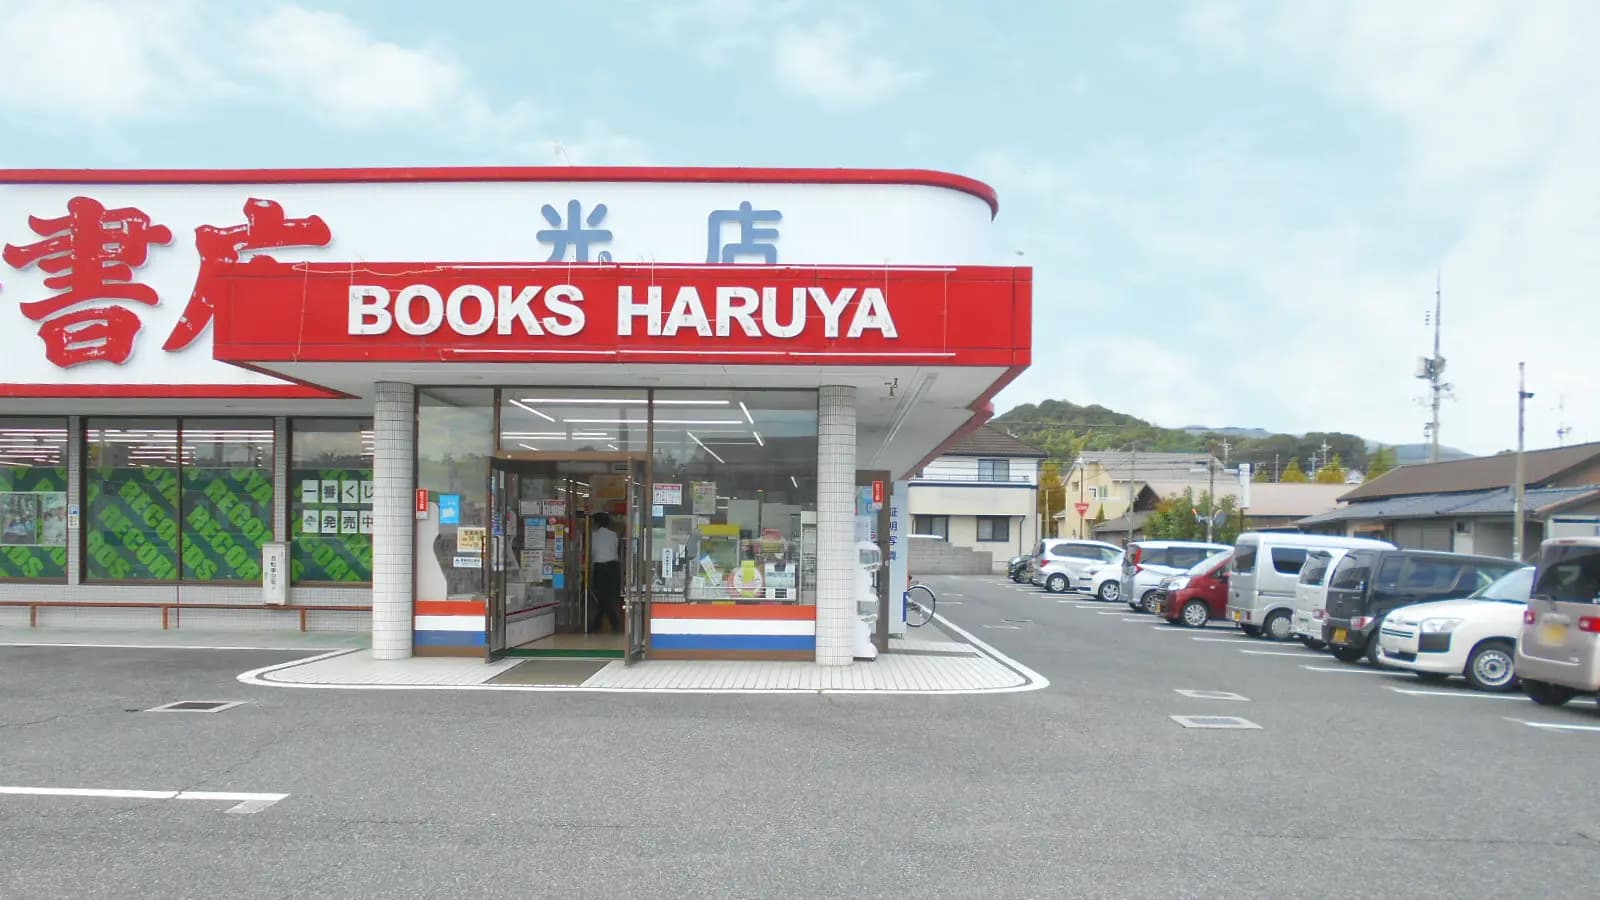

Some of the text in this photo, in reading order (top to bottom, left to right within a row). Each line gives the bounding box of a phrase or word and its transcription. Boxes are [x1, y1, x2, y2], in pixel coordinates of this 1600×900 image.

[348, 284, 898, 338] BOOKS HARUYA
[304, 484, 373, 500] 一番くじ
